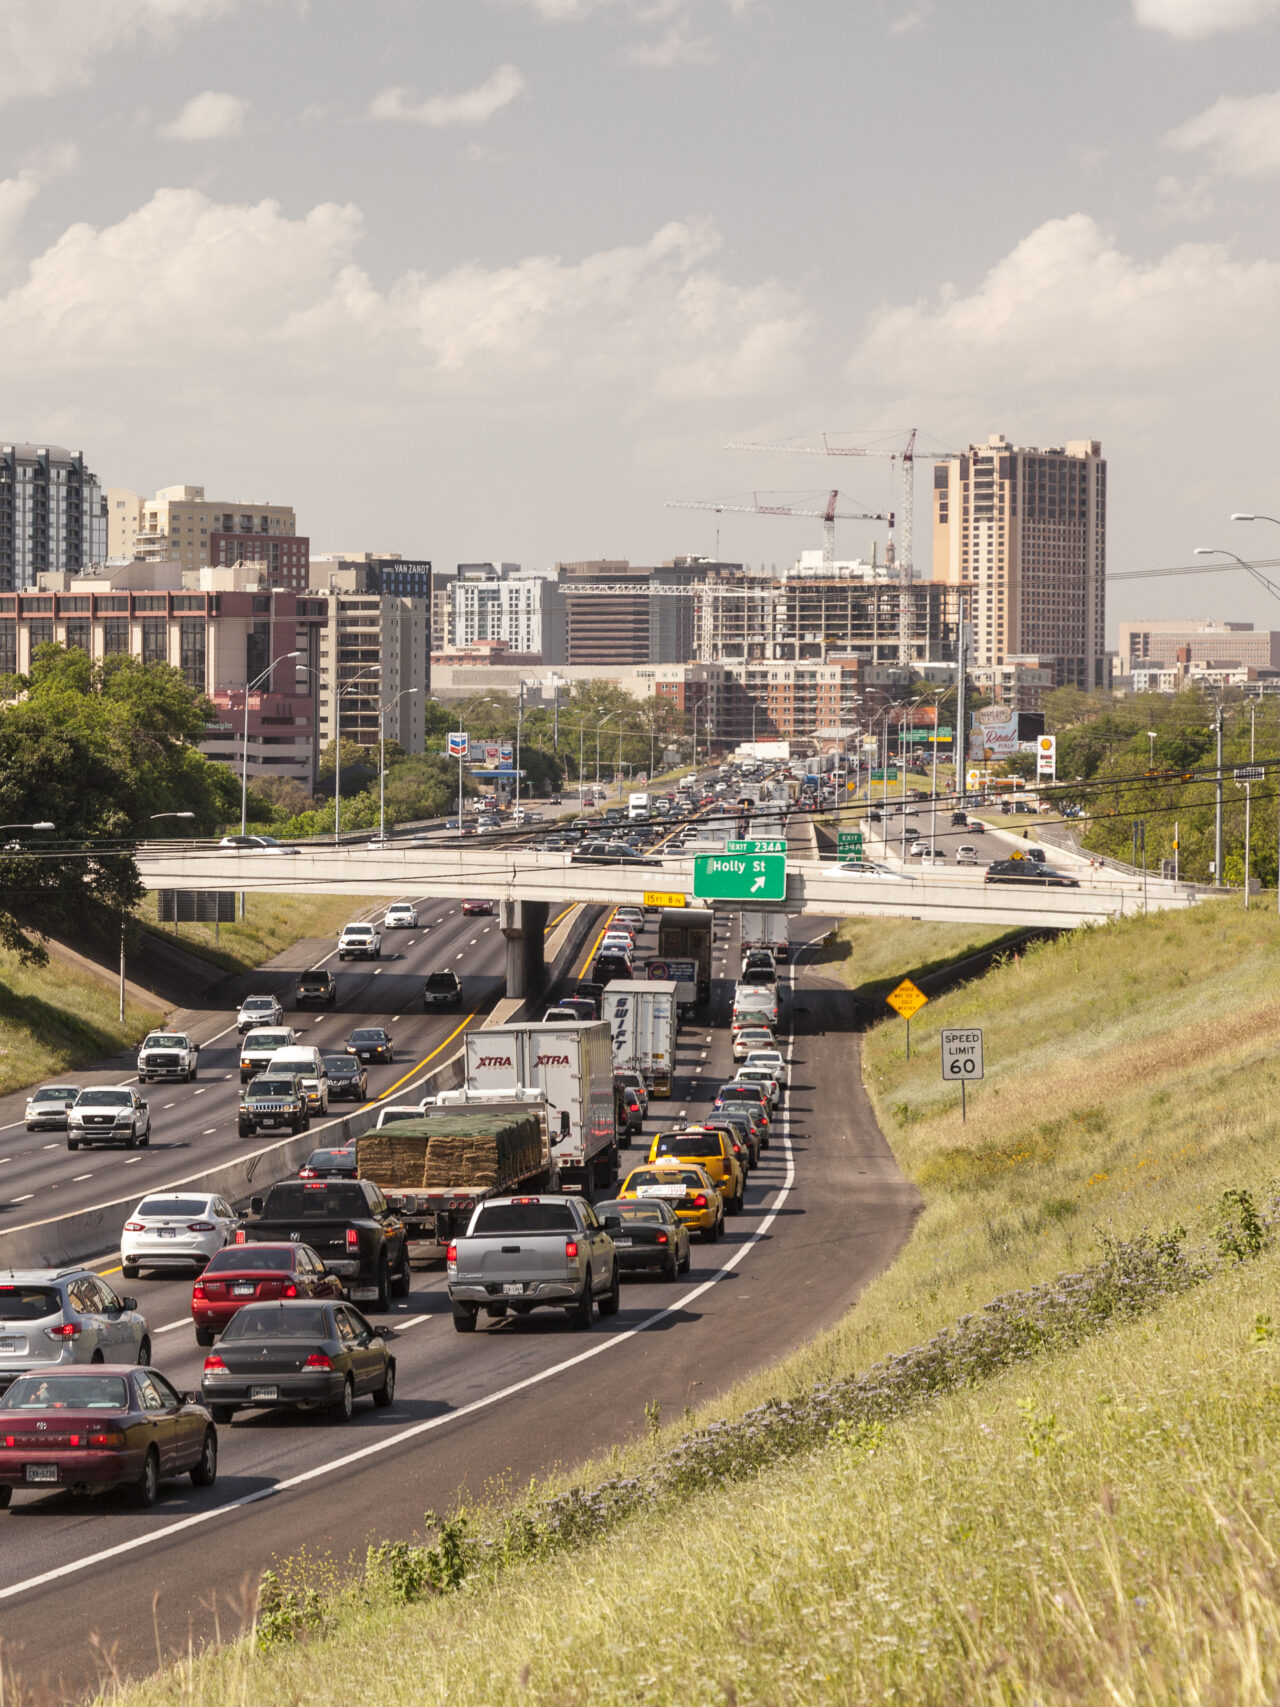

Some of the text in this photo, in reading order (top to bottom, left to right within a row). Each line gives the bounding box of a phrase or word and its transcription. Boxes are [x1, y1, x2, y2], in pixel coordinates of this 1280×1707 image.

[394, 564, 408, 573] VAN
[408, 564, 430, 574] ZANDT
[985, 729, 1017, 744] Real
[731, 842, 782, 852] EXIT 234A
[713, 860, 766, 874] Holly St
[614, 998, 630, 1050] SWIFT
[945, 1034, 980, 1044] SPEED
[949, 1046, 976, 1056] LIMIT
[475, 1056, 512, 1070] XTRA
[533, 1054, 570, 1068] XTRA
[949, 1058, 976, 1075] 60
